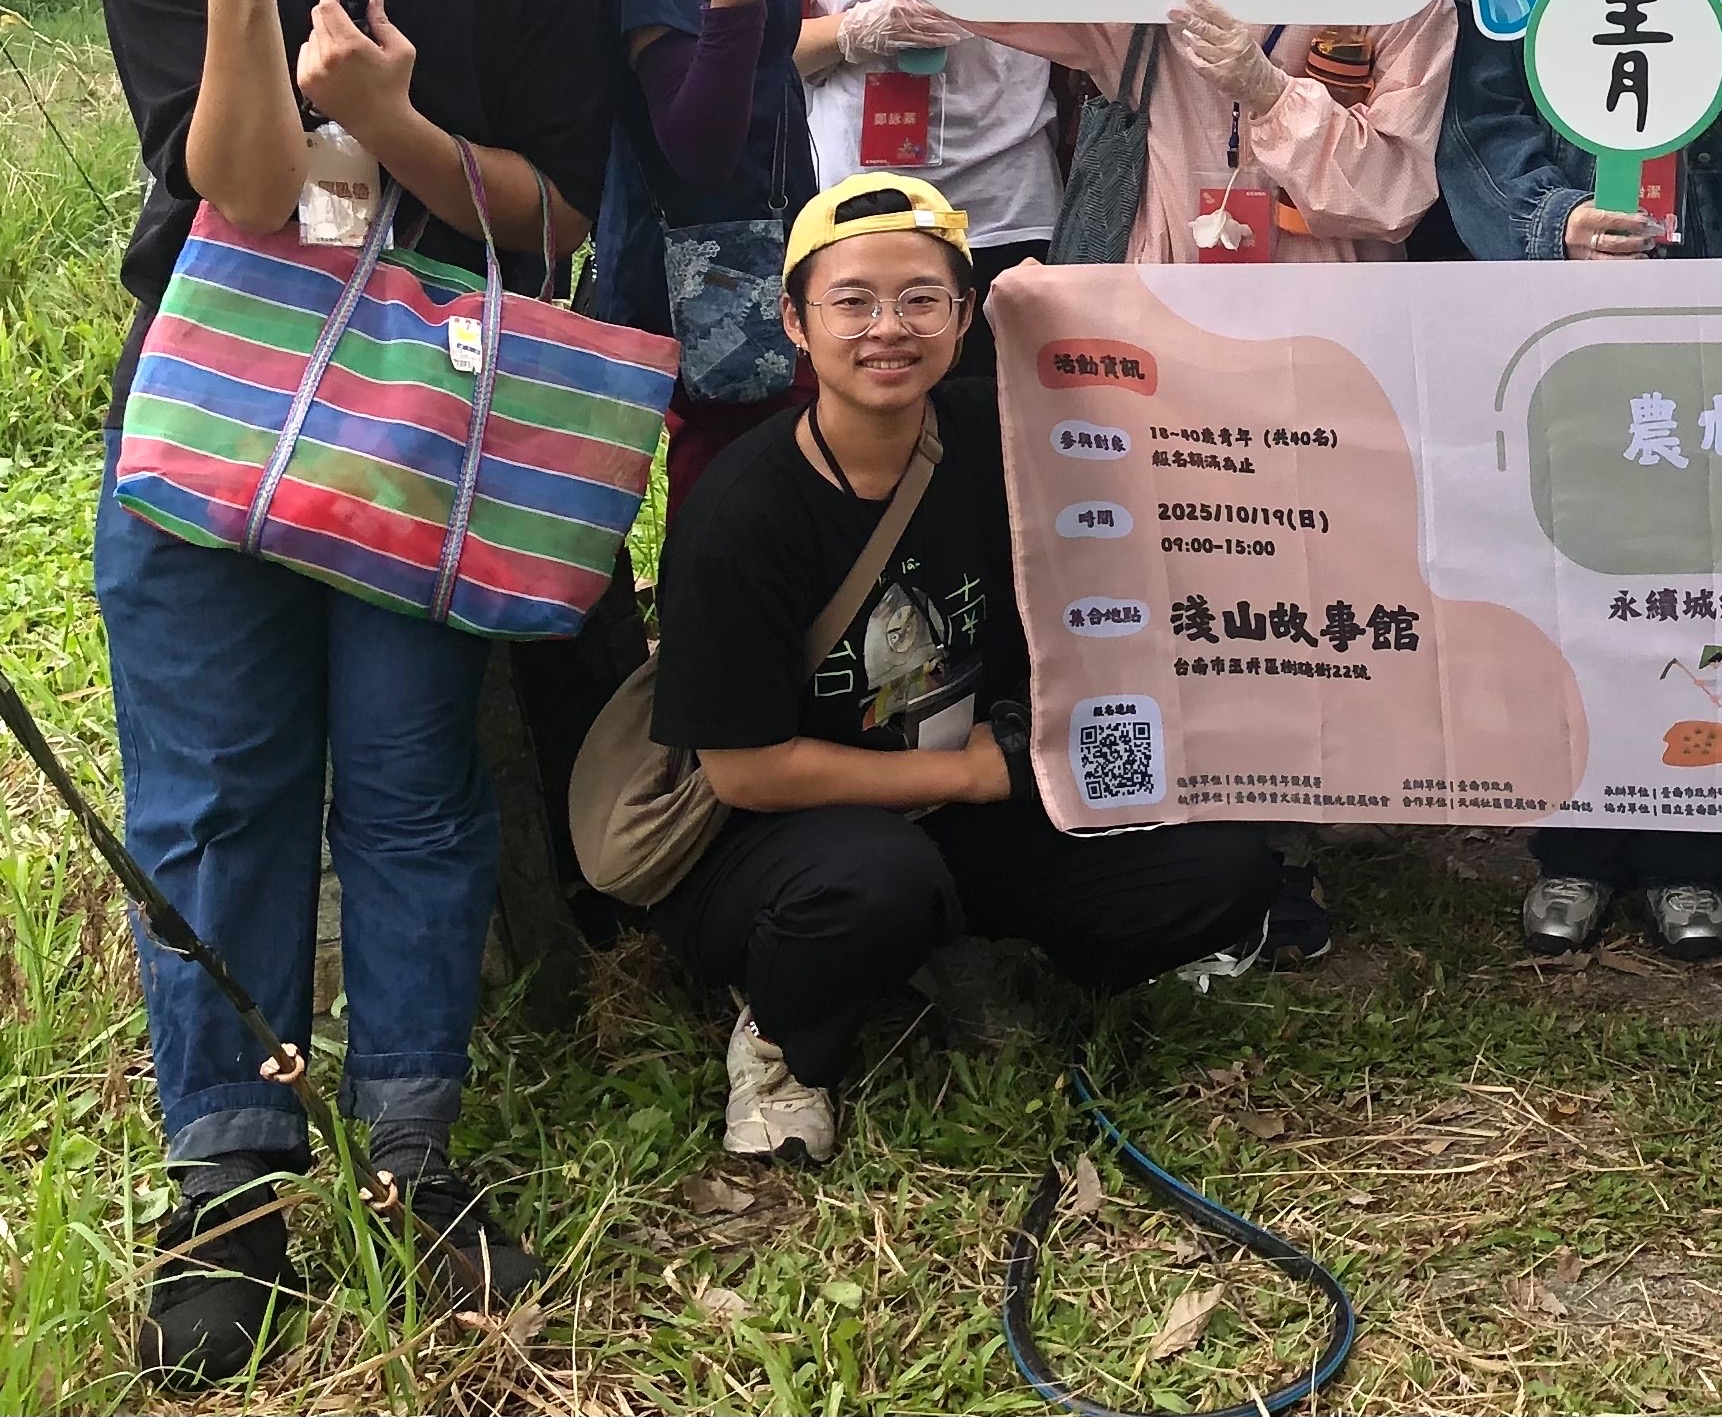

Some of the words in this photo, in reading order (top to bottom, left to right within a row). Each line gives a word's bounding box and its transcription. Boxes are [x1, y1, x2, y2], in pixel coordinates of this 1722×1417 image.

[1053, 353, 1145, 380] 活動資訊
[1077, 509, 1114, 528] 時間
[1161, 537, 1276, 557] 09:00-15:00
[1068, 607, 1142, 627] 集合地點
[1170, 594, 1421, 653] 淺山故事館
